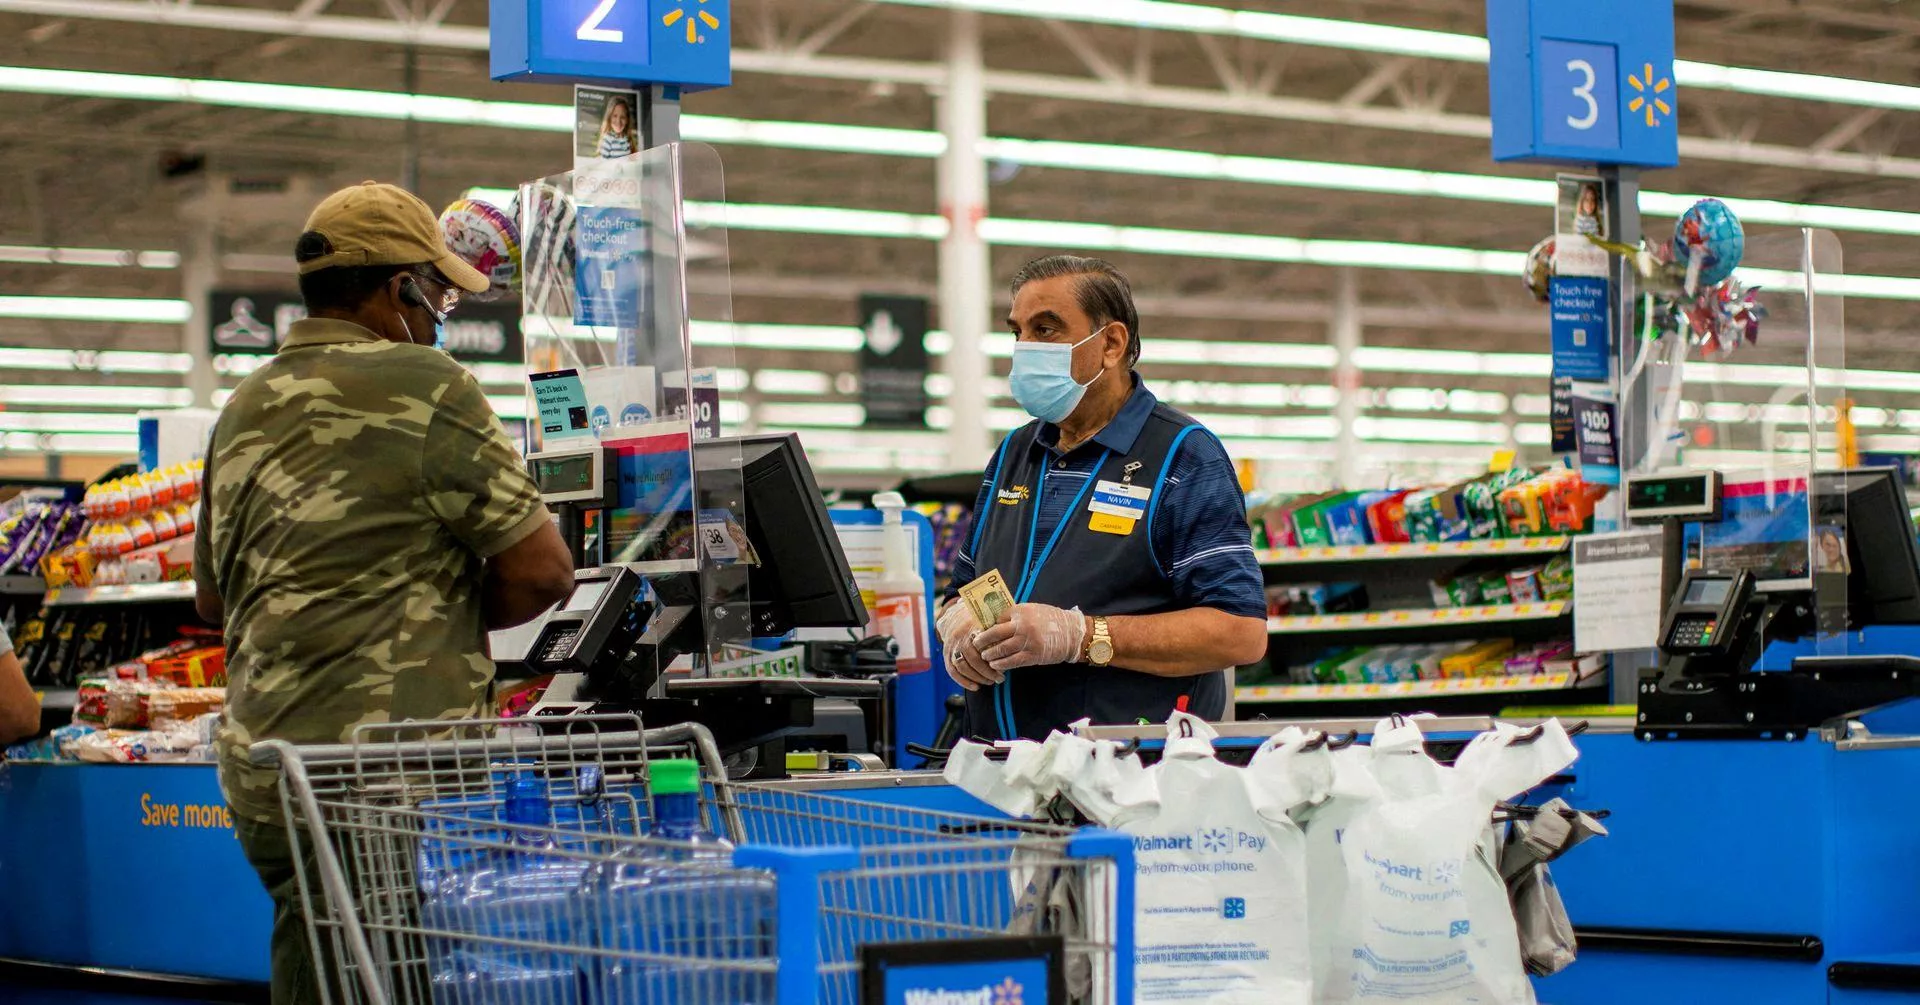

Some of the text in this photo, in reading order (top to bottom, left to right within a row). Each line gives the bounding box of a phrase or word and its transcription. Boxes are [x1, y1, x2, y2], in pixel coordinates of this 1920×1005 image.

[576, 0, 623, 43] 2
[1567, 59, 1598, 130] 3
[582, 214, 637, 231] Touch-free
[582, 230, 628, 245] checkout
[1554, 283, 1602, 297] Touch-free
[1554, 297, 1595, 309] checkout
[1581, 410, 1610, 430] $100
[1583, 428, 1611, 444] Bonus
[1107, 495, 1132, 506] NAVIN
[987, 575, 999, 589] 10
[141, 793, 237, 836] Save mone
[1238, 831, 1266, 852] Pay
[1214, 860, 1257, 876] phone.
[1380, 882, 1407, 899] from
[1410, 891, 1439, 903] your
[904, 984, 994, 1005] Walmart
